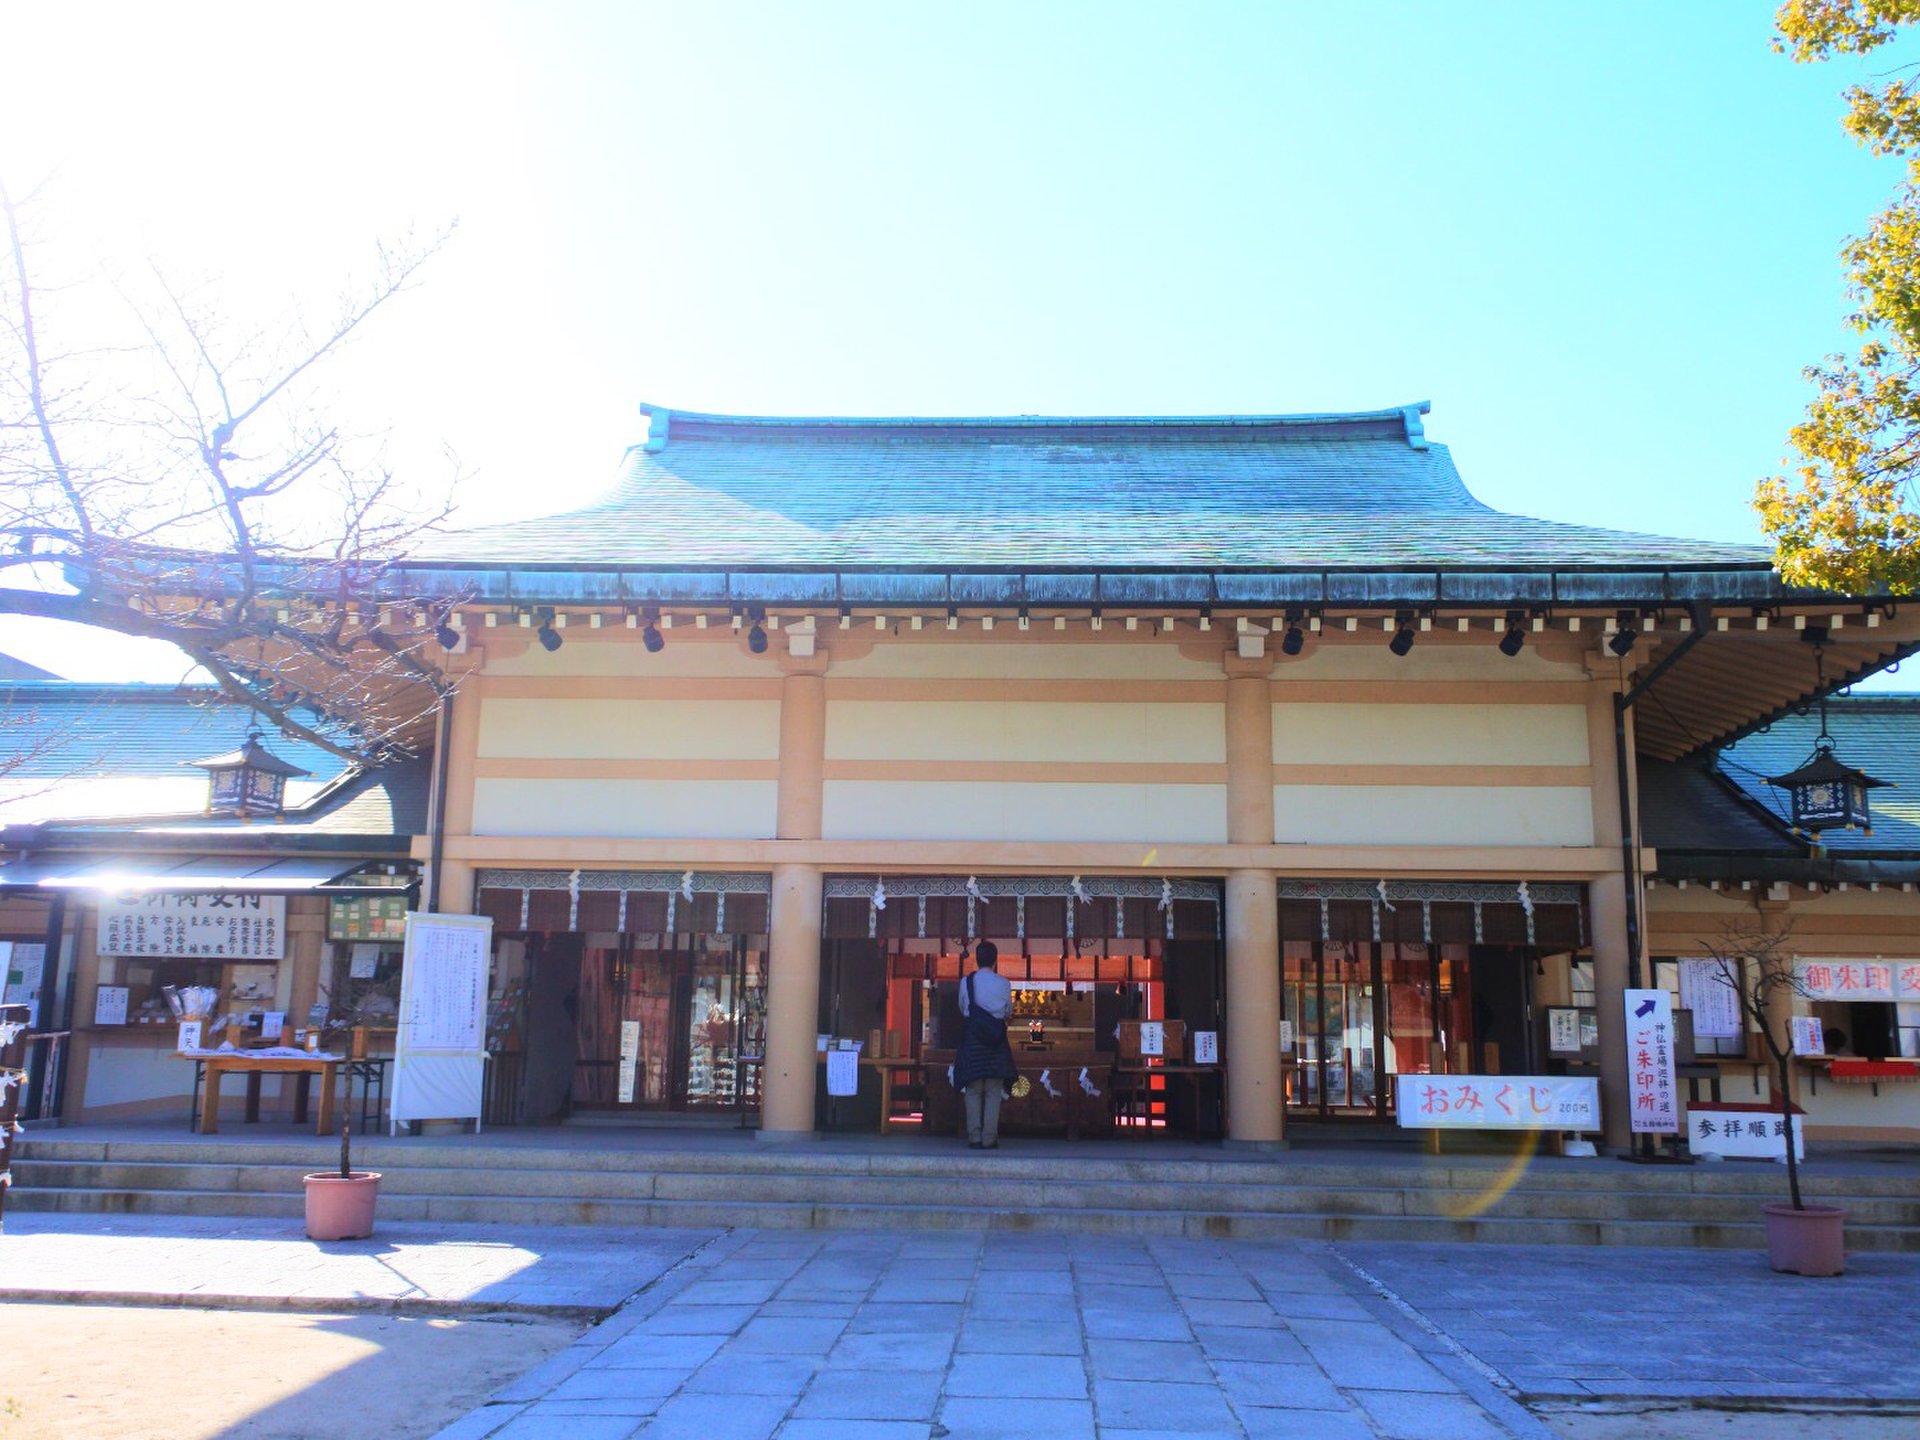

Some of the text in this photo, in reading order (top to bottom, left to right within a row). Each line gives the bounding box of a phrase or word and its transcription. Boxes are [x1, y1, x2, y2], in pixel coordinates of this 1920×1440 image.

[1419, 1083, 1590, 1116] おみくじ 200円
[1636, 1030, 1656, 1112] ご朱印所
